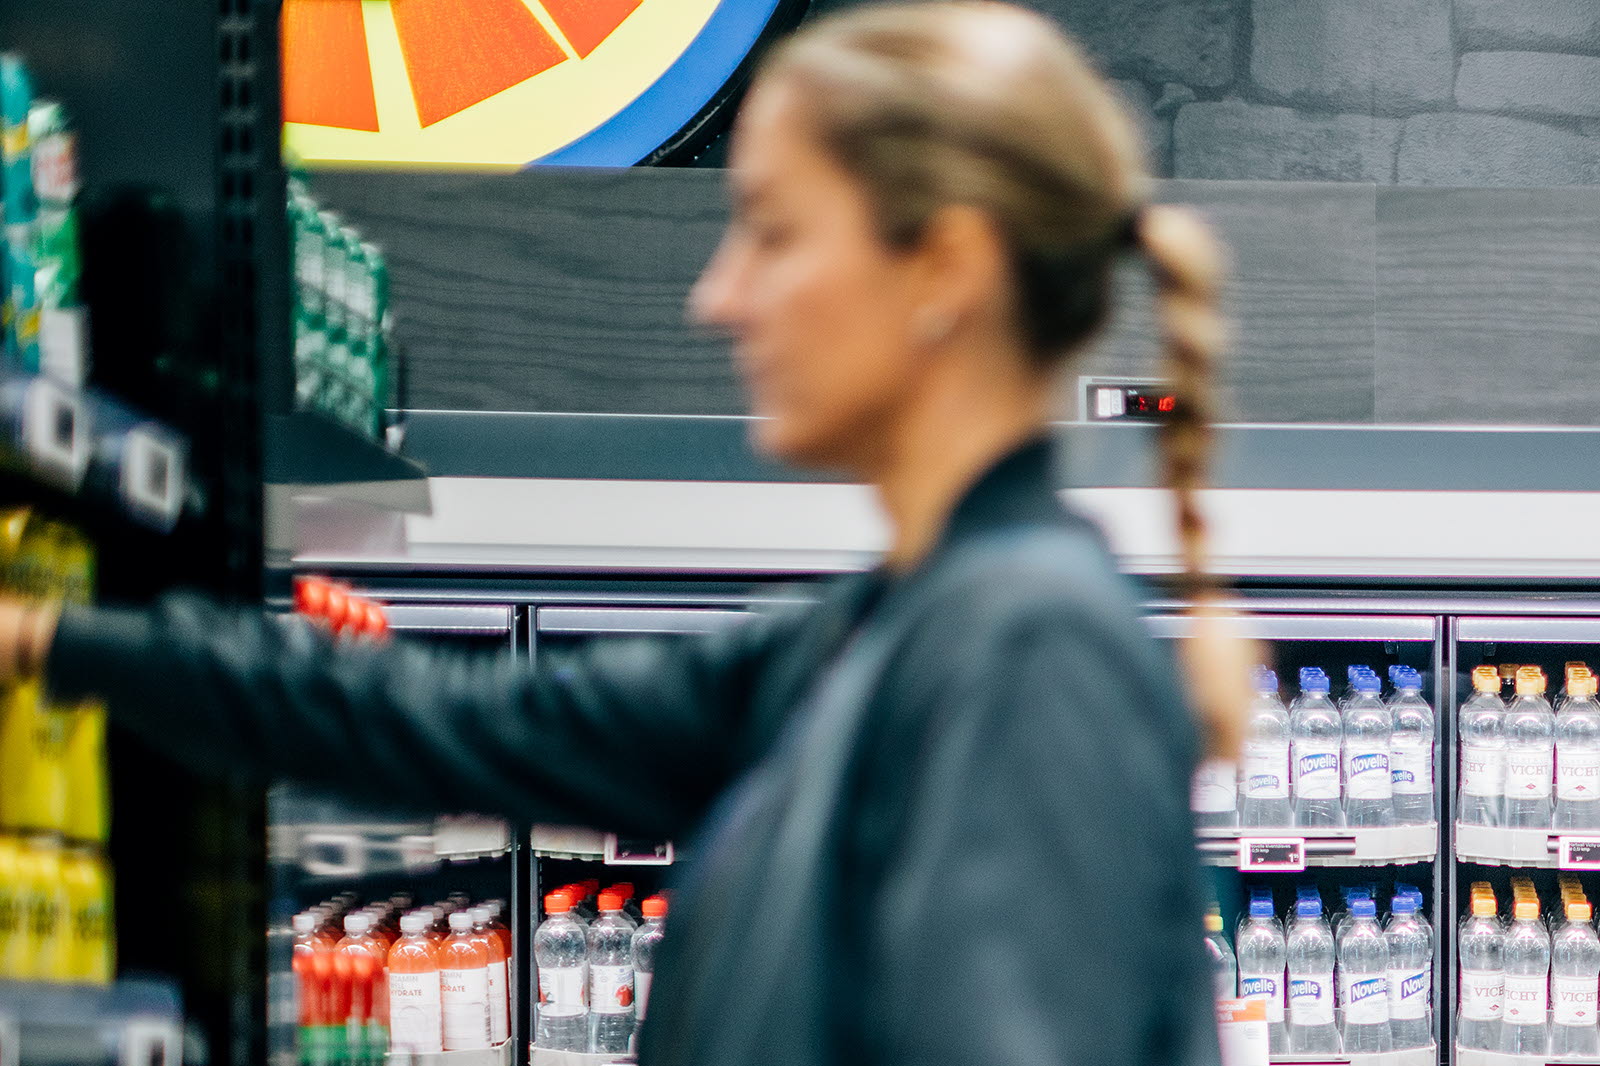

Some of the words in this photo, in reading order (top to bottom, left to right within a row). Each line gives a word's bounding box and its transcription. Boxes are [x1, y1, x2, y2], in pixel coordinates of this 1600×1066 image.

[1301, 755, 1336, 775] Novelle
[1352, 755, 1387, 775] Novelle
[1392, 771, 1413, 782] ovelle
[1291, 981, 1318, 995] ovelle
[1403, 976, 1424, 998] Nove
